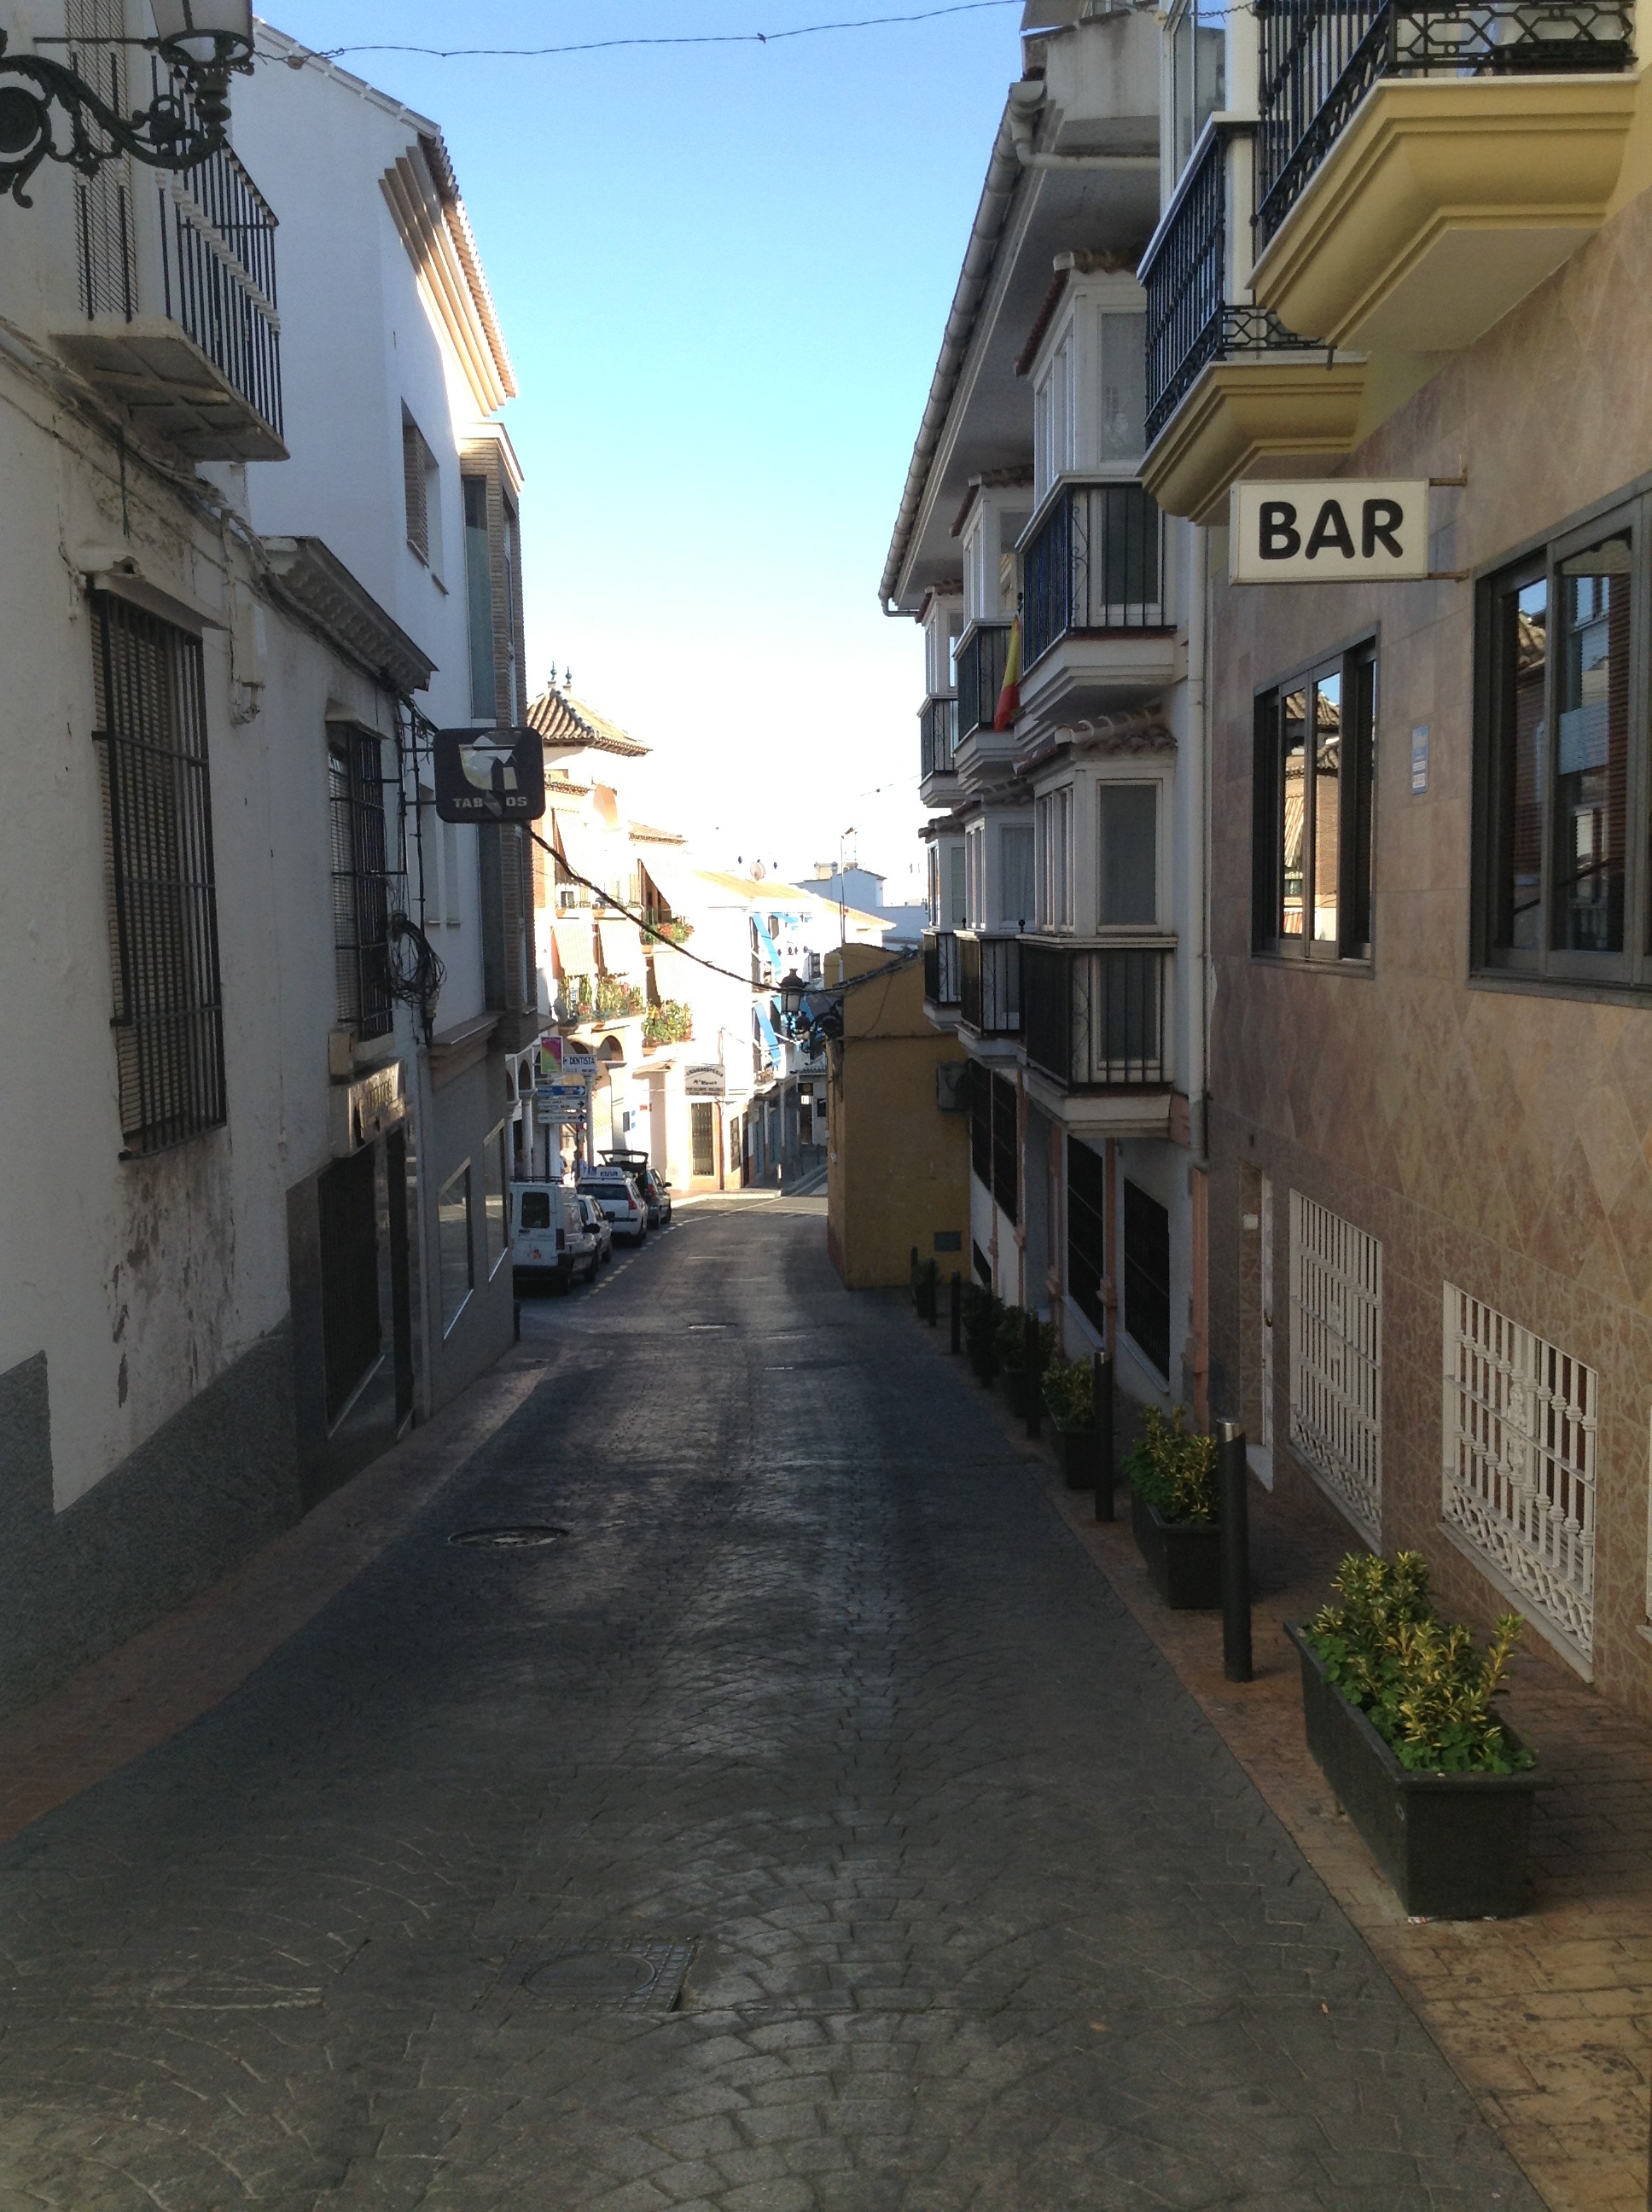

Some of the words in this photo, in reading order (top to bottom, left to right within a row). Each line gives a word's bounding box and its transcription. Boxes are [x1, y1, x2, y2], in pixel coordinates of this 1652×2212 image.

[1259, 499, 1405, 560] BAR
[452, 796, 528, 809] TABOS
[569, 1057, 595, 1065] DENTISTA
